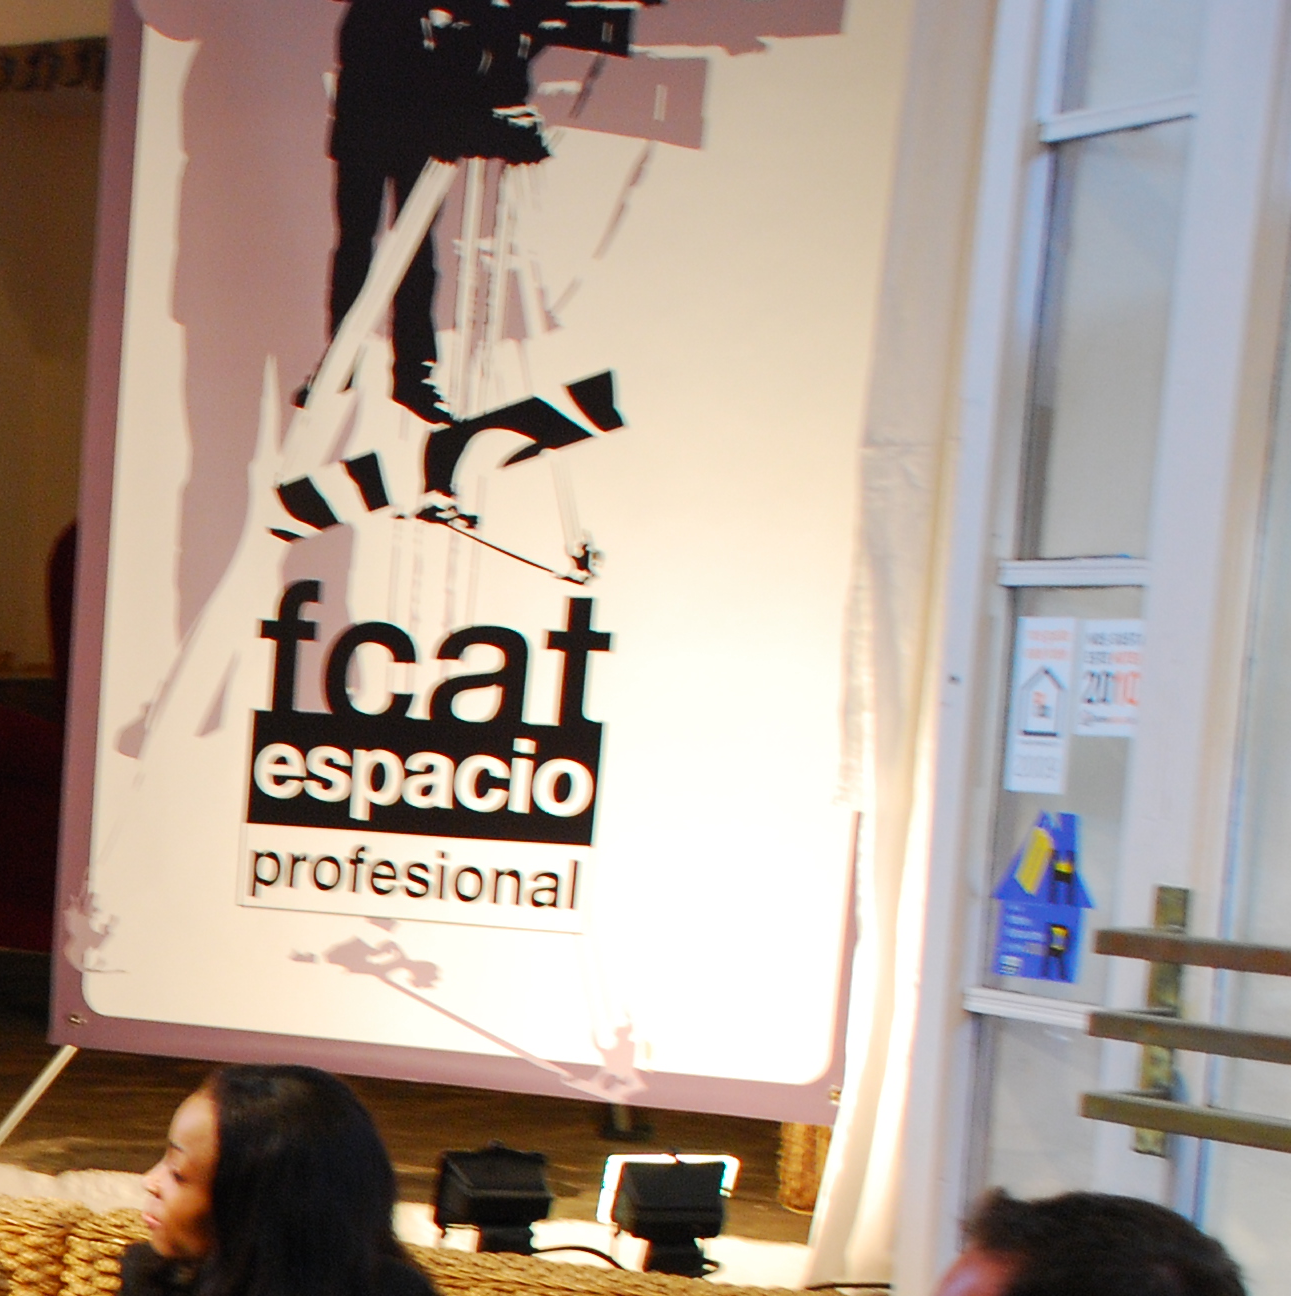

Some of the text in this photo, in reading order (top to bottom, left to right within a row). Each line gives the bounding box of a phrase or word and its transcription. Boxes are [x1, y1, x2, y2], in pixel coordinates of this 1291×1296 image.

[259, 578, 613, 726] fcat
[253, 737, 595, 821] espacio
[247, 845, 582, 910] profesional
